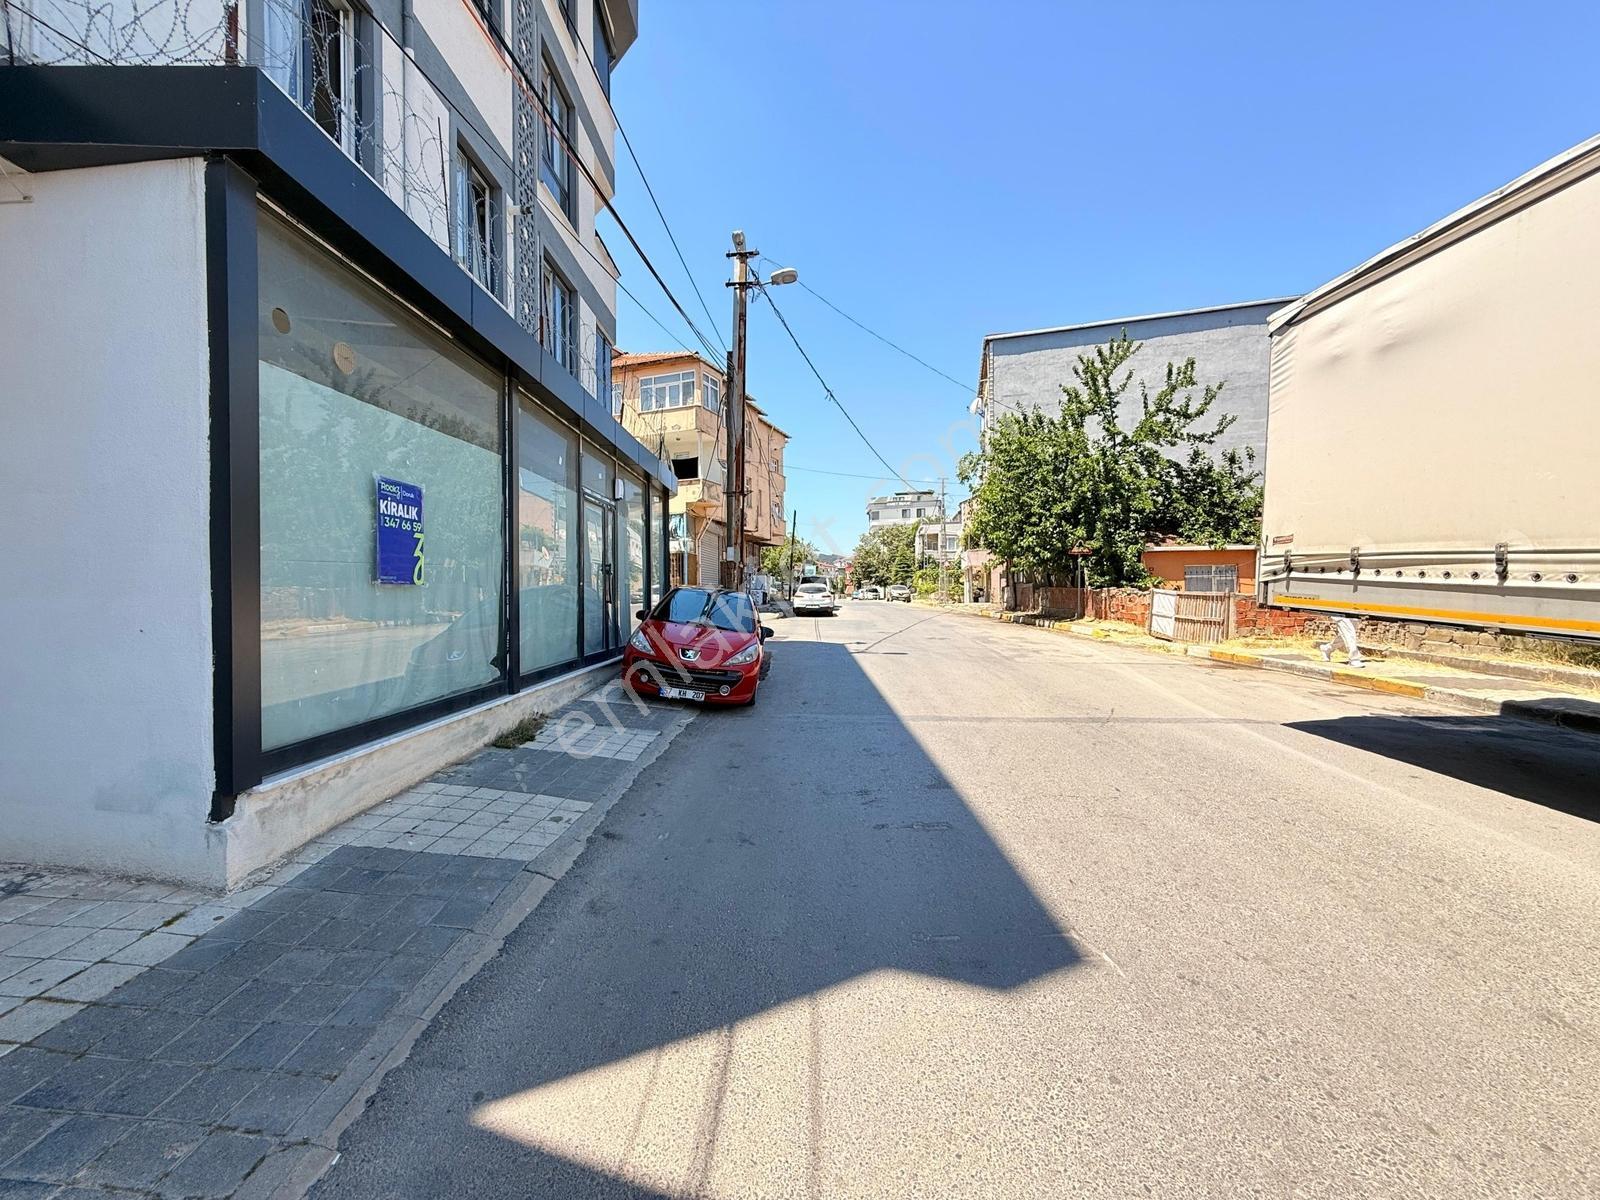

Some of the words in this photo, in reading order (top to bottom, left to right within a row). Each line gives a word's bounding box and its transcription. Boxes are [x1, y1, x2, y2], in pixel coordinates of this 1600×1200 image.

[380, 497, 418, 520] KİRALIK
[385, 517, 399, 528] 347
[402, 520, 411, 531] 66
[413, 523, 421, 532] 59
[678, 689, 687, 697] KH
[692, 691, 704, 700] 207
